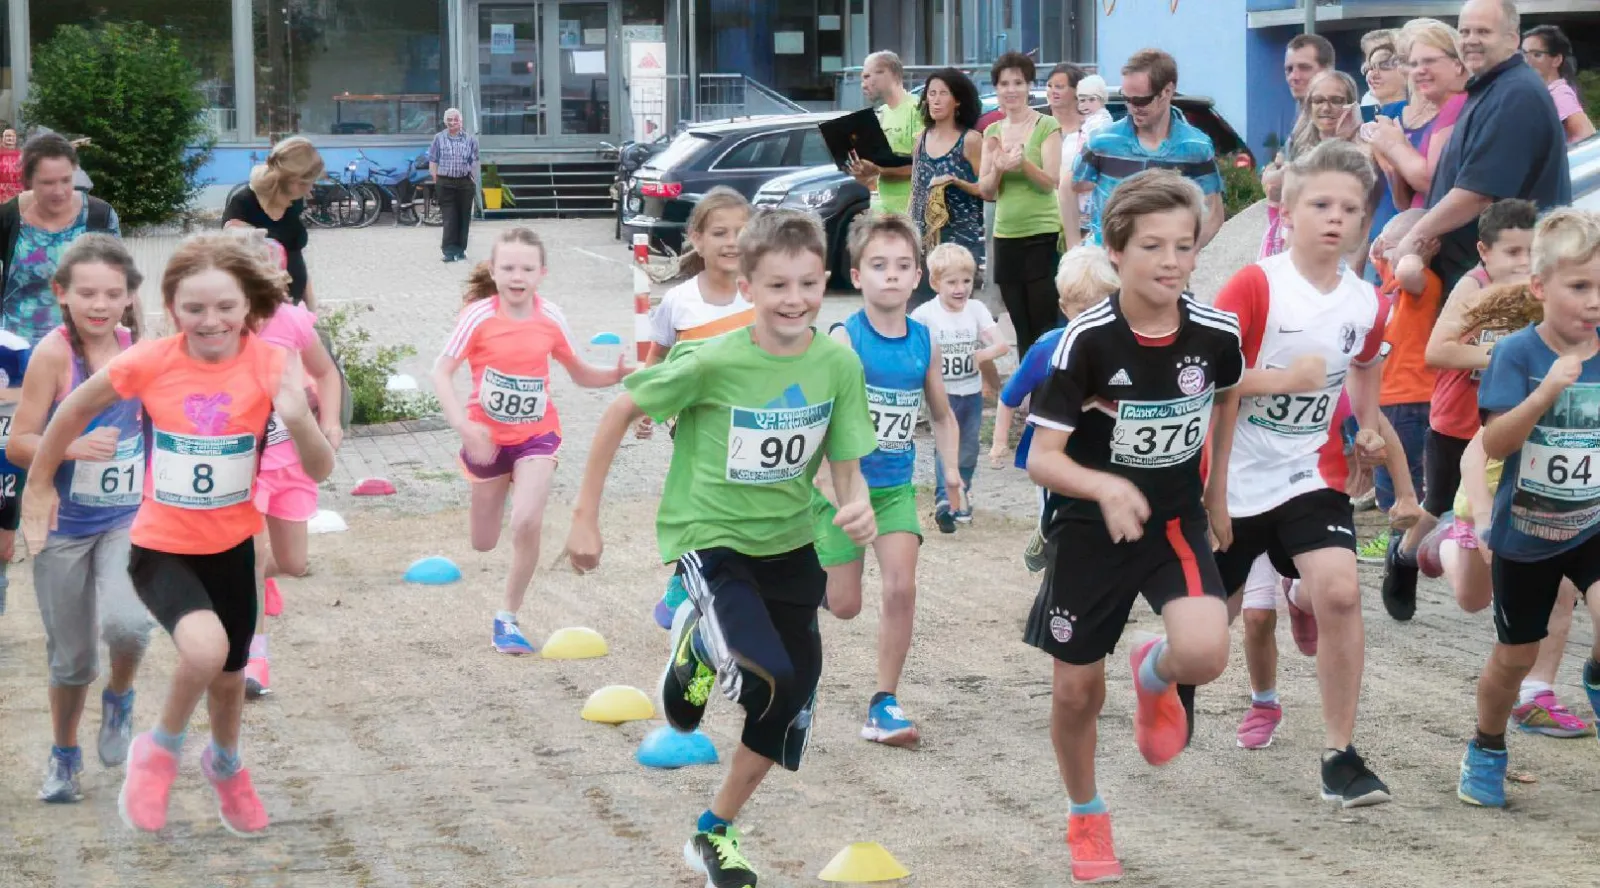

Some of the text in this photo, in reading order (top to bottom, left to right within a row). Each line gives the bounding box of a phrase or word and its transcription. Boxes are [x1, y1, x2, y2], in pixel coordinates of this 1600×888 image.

[489, 391, 537, 415] 383
[1266, 393, 1330, 424] 378
[731, 436, 746, 460] 2
[760, 434, 805, 468] 90
[1133, 417, 1201, 455] 376
[101, 464, 135, 493] 61
[193, 463, 214, 494] 8
[1547, 454, 1593, 485] 64
